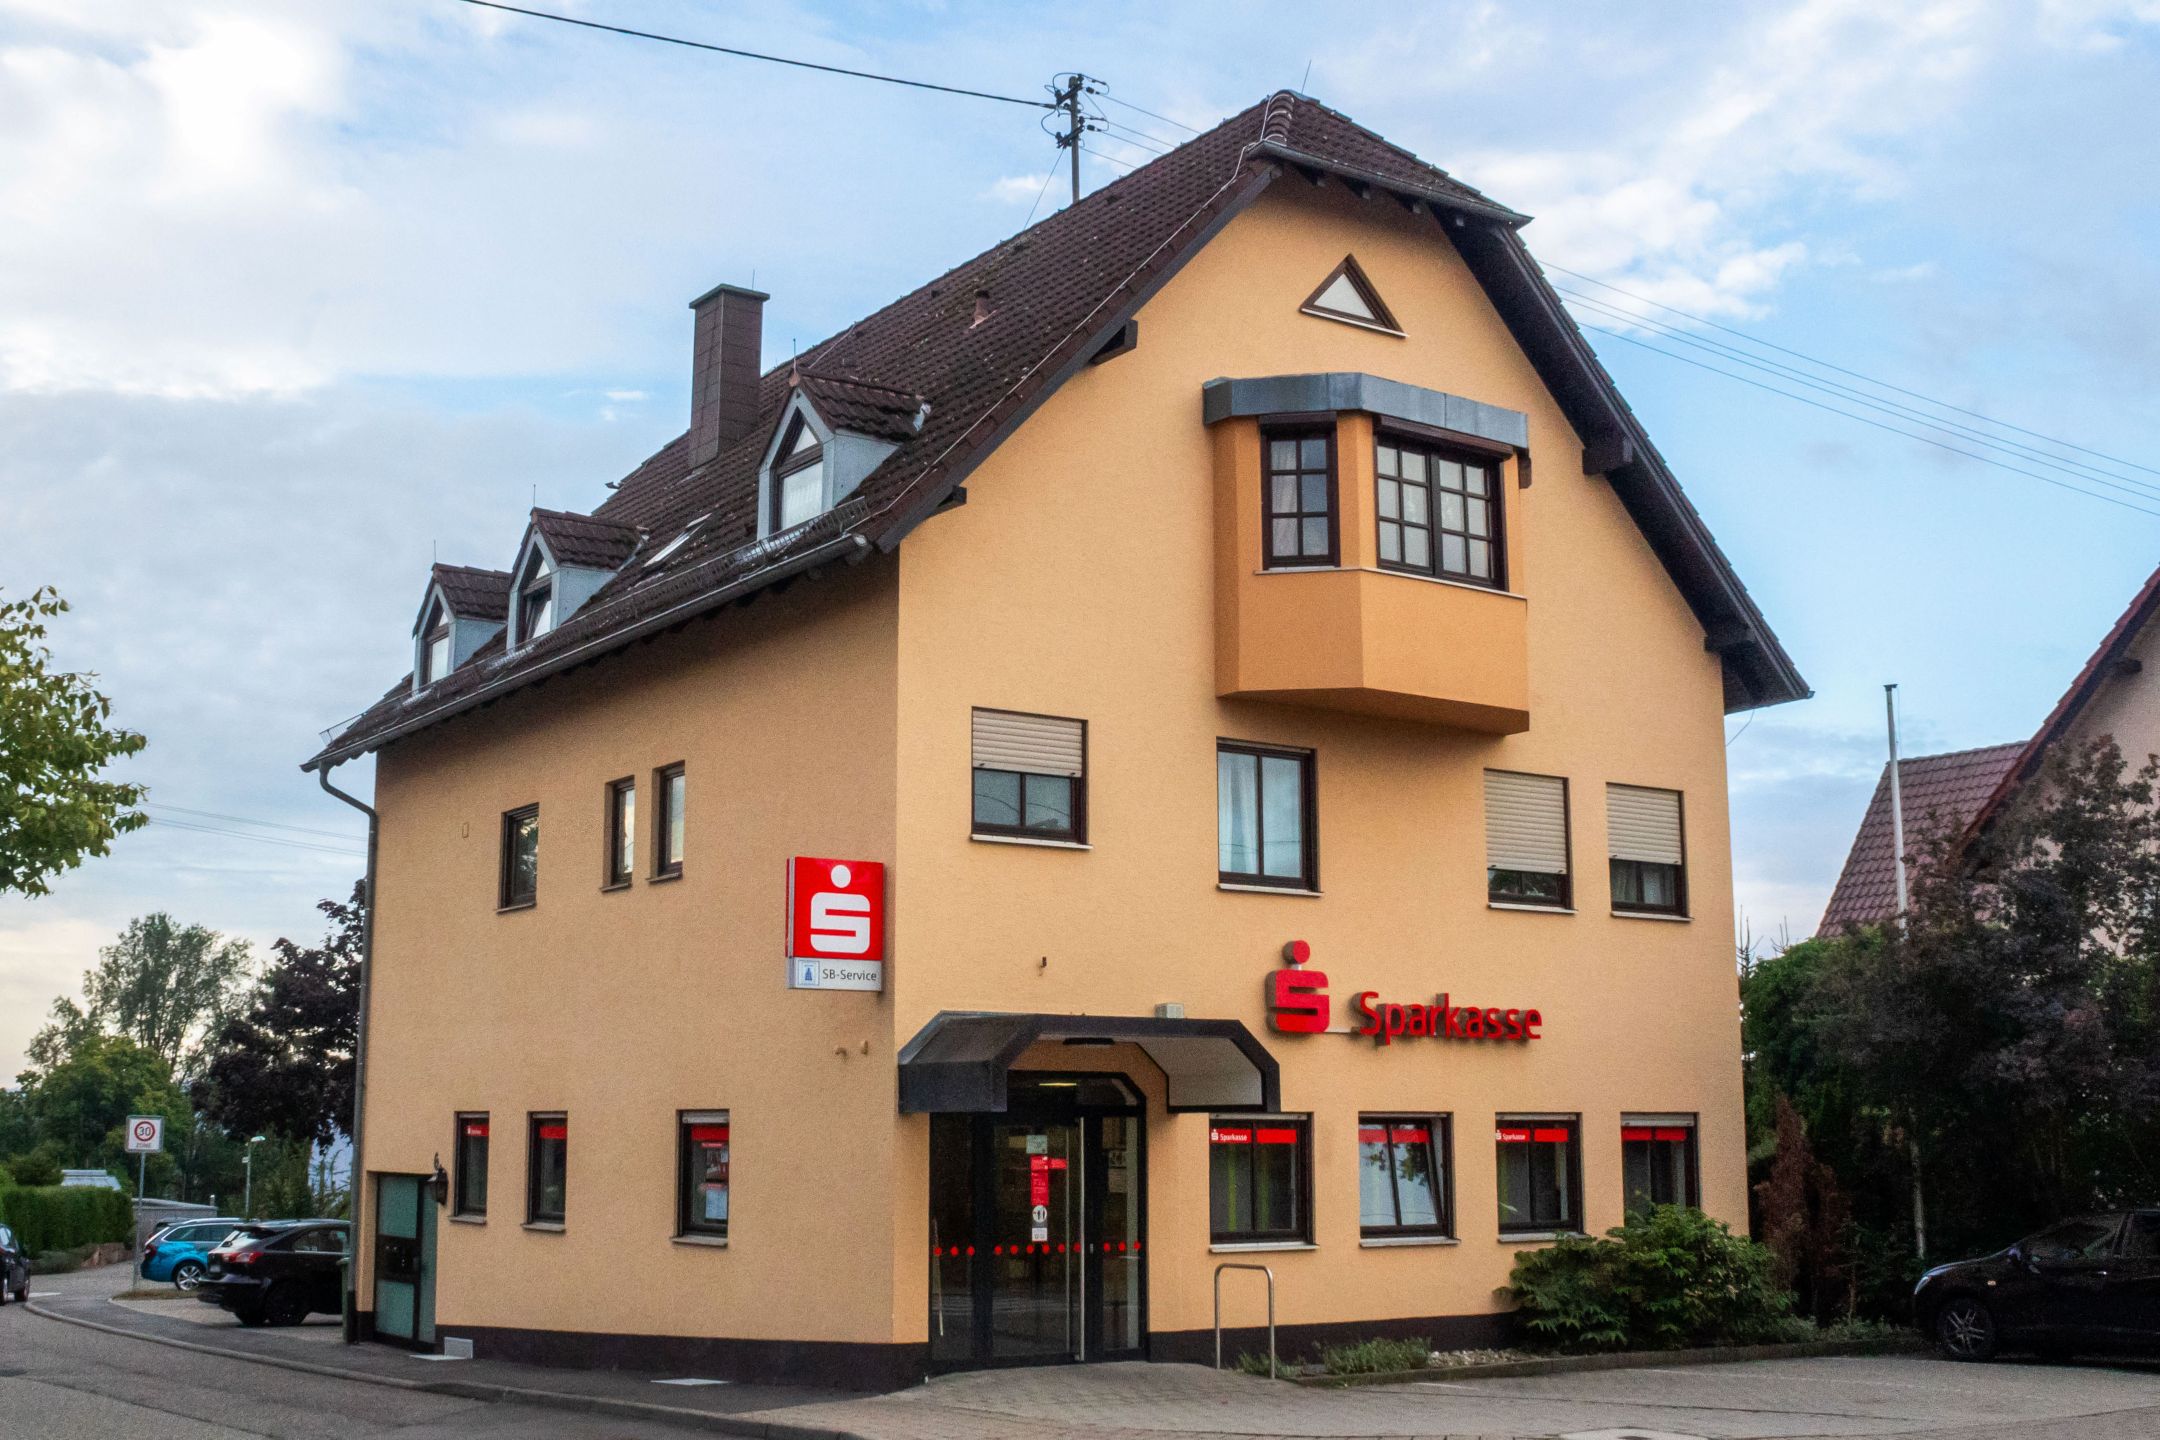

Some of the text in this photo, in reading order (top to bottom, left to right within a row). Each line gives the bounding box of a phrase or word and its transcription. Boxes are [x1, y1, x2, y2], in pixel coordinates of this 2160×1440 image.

[822, 968, 877, 981] SB-Service
[1358, 991, 1542, 1045] Sparkasse
[138, 1126, 151, 1136] 30
